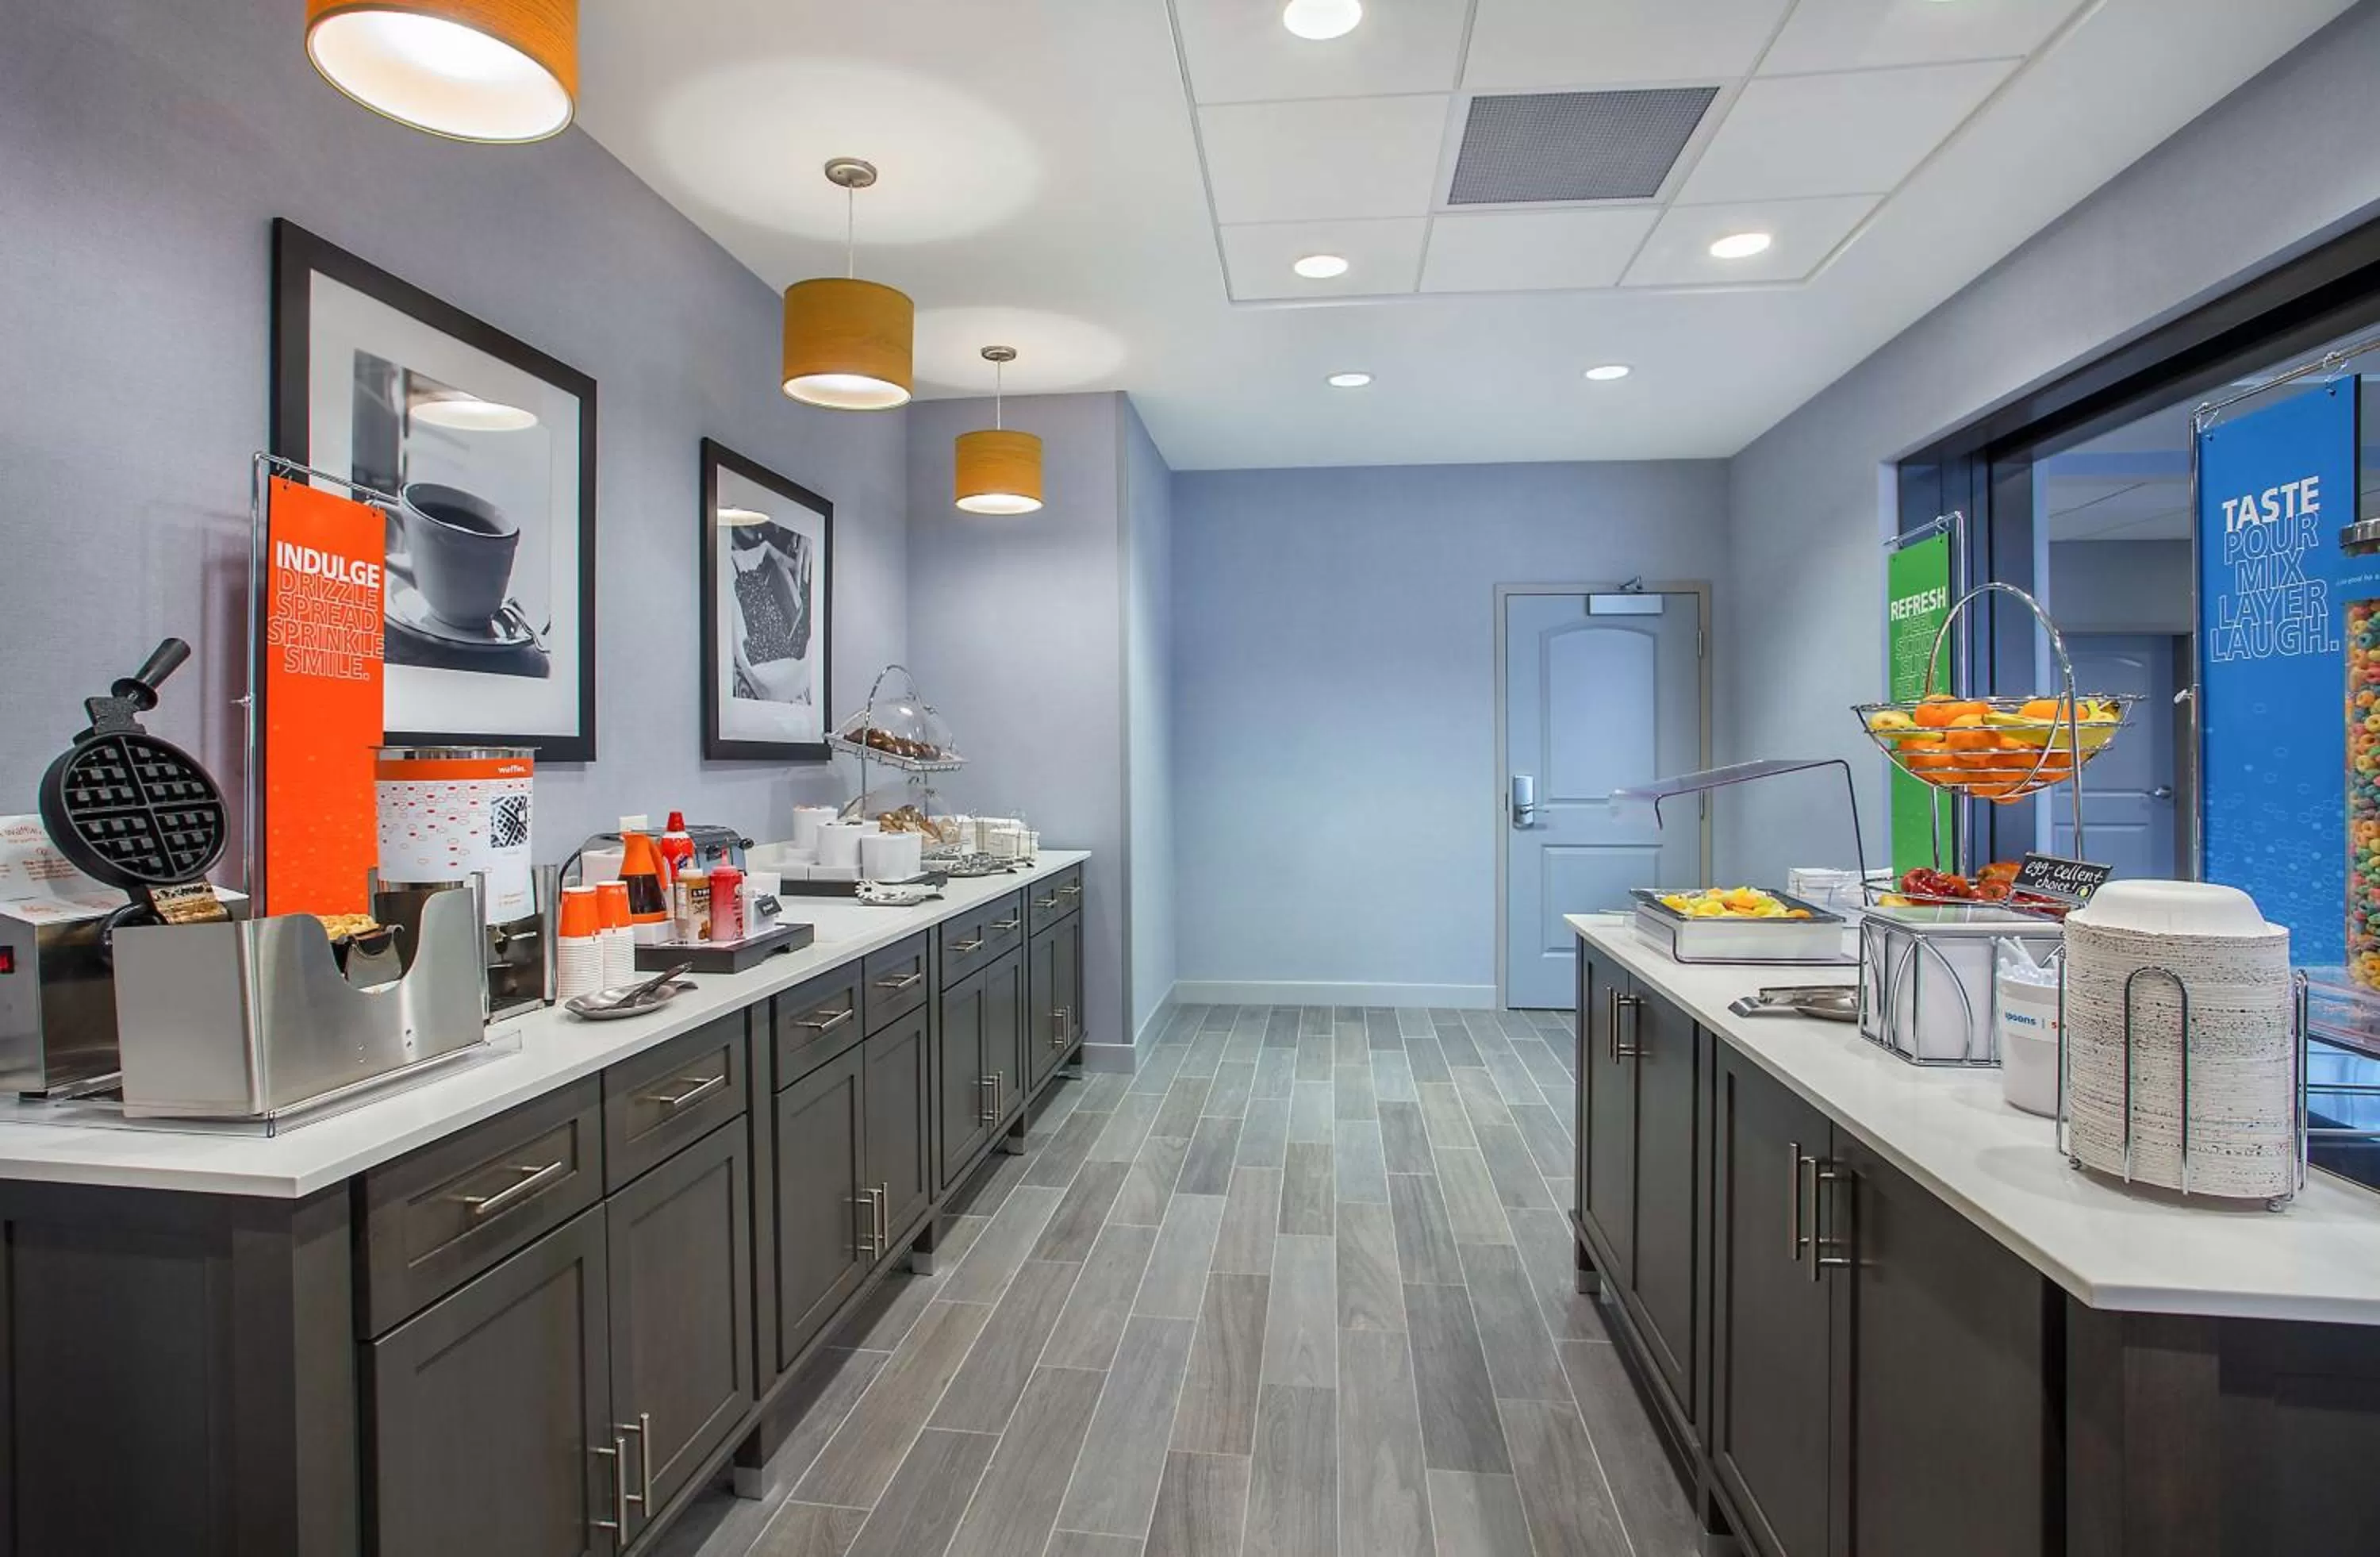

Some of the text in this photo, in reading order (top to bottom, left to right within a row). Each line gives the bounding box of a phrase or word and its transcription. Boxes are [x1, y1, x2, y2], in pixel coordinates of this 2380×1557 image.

[2222, 476, 2320, 533] TASTE
[2224, 512, 2320, 565] POUR
[276, 540, 381, 589] INDULGE
[278, 567, 378, 610] DRIZZLE
[2235, 547, 2305, 595] MIX
[277, 593, 378, 632] SPREAD
[1891, 586, 1947, 621] REFRESH
[2218, 579, 2329, 629] LAYER
[267, 616, 385, 659] SPRINKLE
[2209, 614, 2340, 663] LAUGH.
[285, 645, 370, 682] SMILE.
